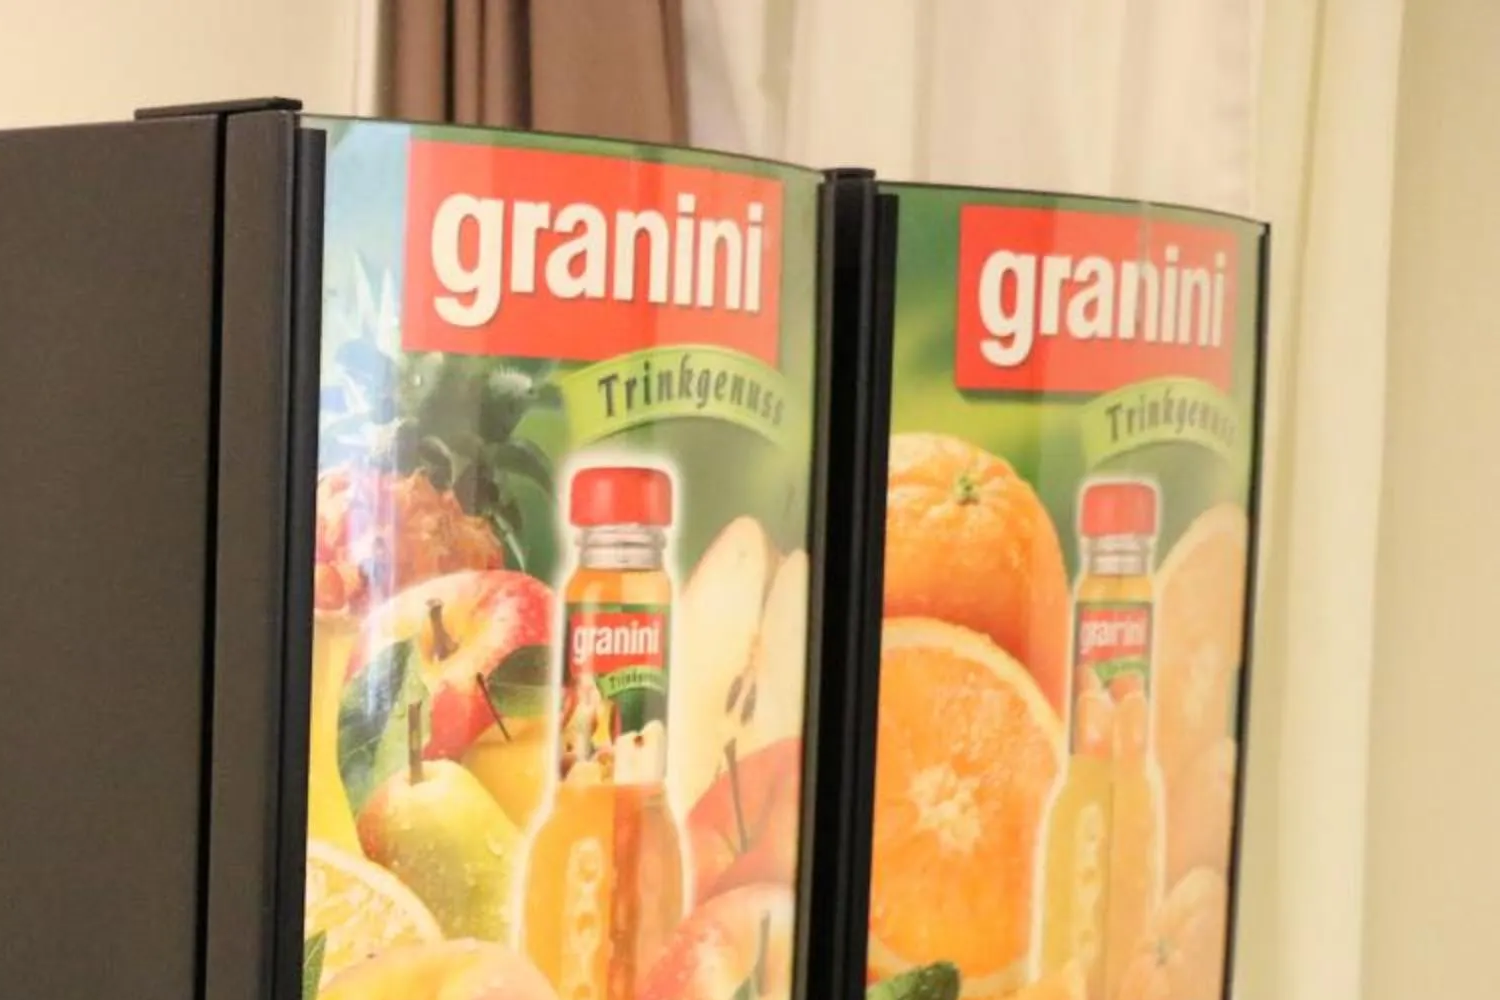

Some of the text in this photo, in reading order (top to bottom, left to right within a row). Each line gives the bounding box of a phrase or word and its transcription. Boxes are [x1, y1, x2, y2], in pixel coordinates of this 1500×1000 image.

[431, 193, 763, 326] granini
[979, 245, 1226, 366] granini
[597, 356, 785, 426] Trinkgenuss
[573, 619, 660, 665] granini
